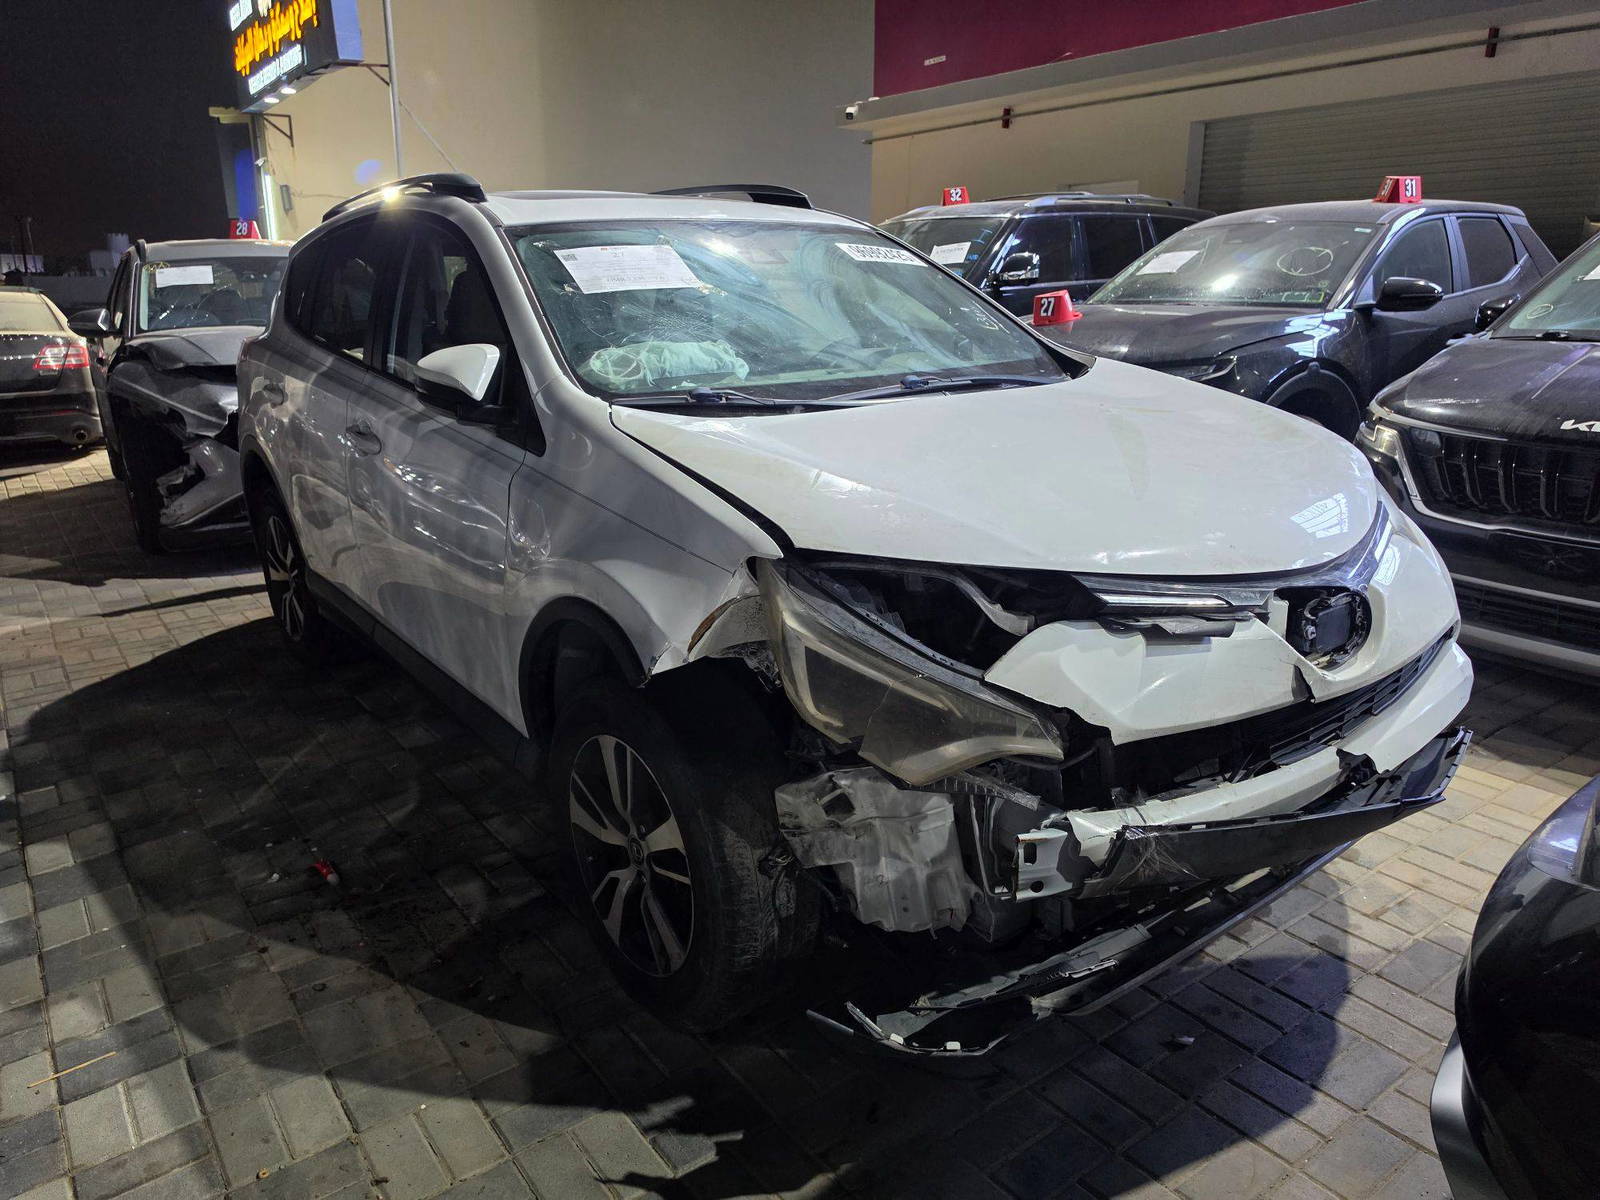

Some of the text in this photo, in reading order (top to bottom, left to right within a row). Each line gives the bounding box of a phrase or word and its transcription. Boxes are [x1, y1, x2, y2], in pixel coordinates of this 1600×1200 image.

[950, 187, 962, 202] 32
[1404, 178, 1417, 198] 31
[236, 221, 248, 236] 28
[1040, 297, 1055, 317] 27
